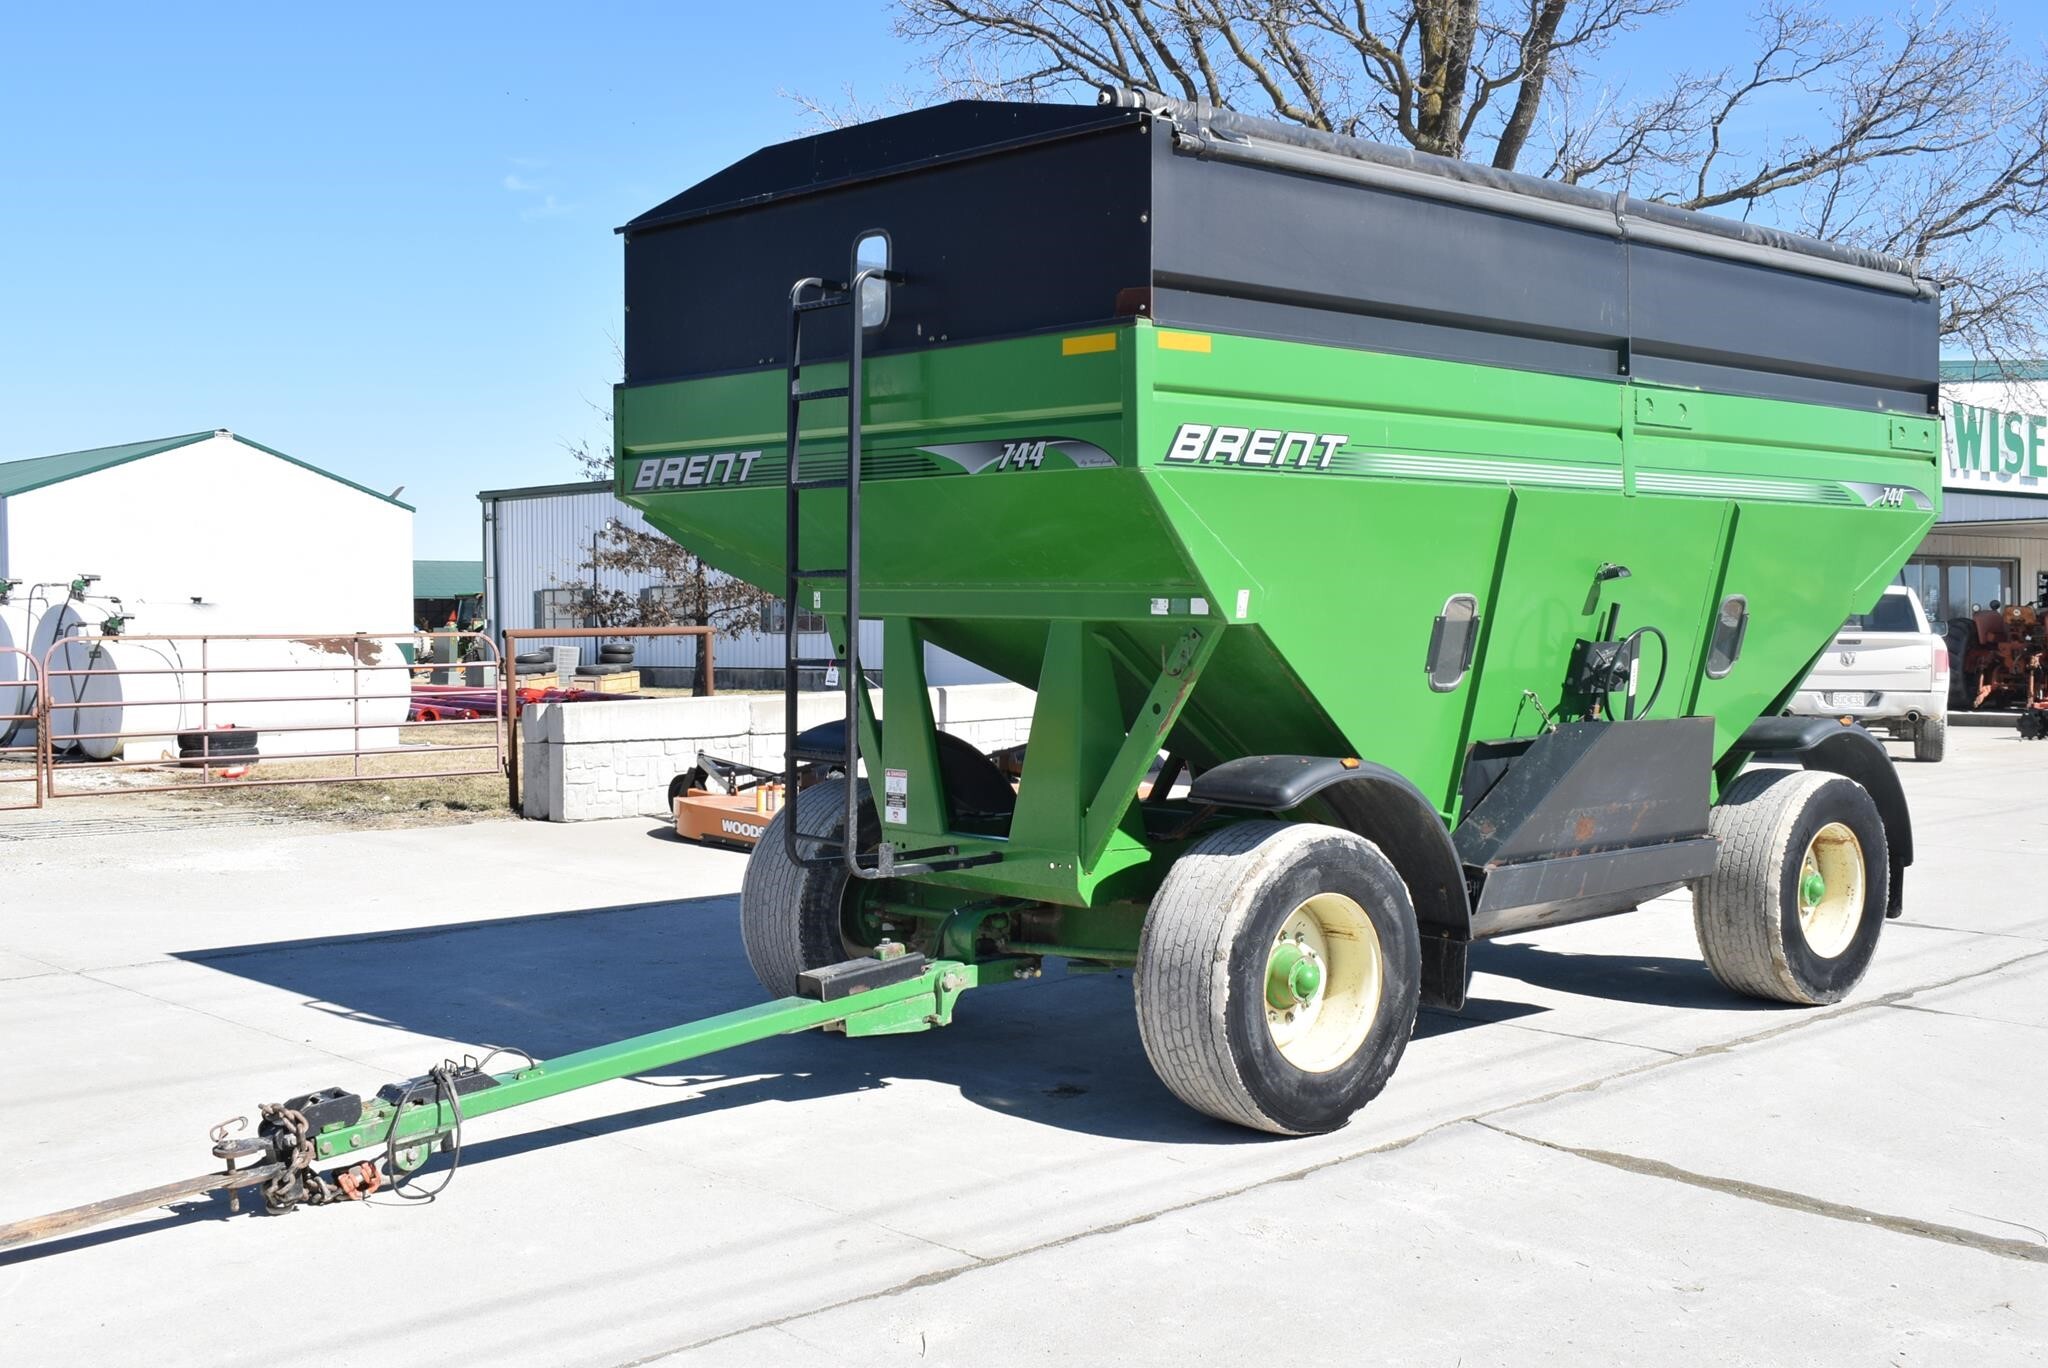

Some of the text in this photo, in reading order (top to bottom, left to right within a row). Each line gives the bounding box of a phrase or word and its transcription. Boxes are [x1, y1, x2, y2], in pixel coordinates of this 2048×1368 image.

[997, 440, 1047, 471] 744
[1164, 422, 1349, 470] BRENT
[1951, 402, 2048, 478] WISE
[633, 450, 763, 491] BRENT
[1880, 487, 1905, 507] 744
